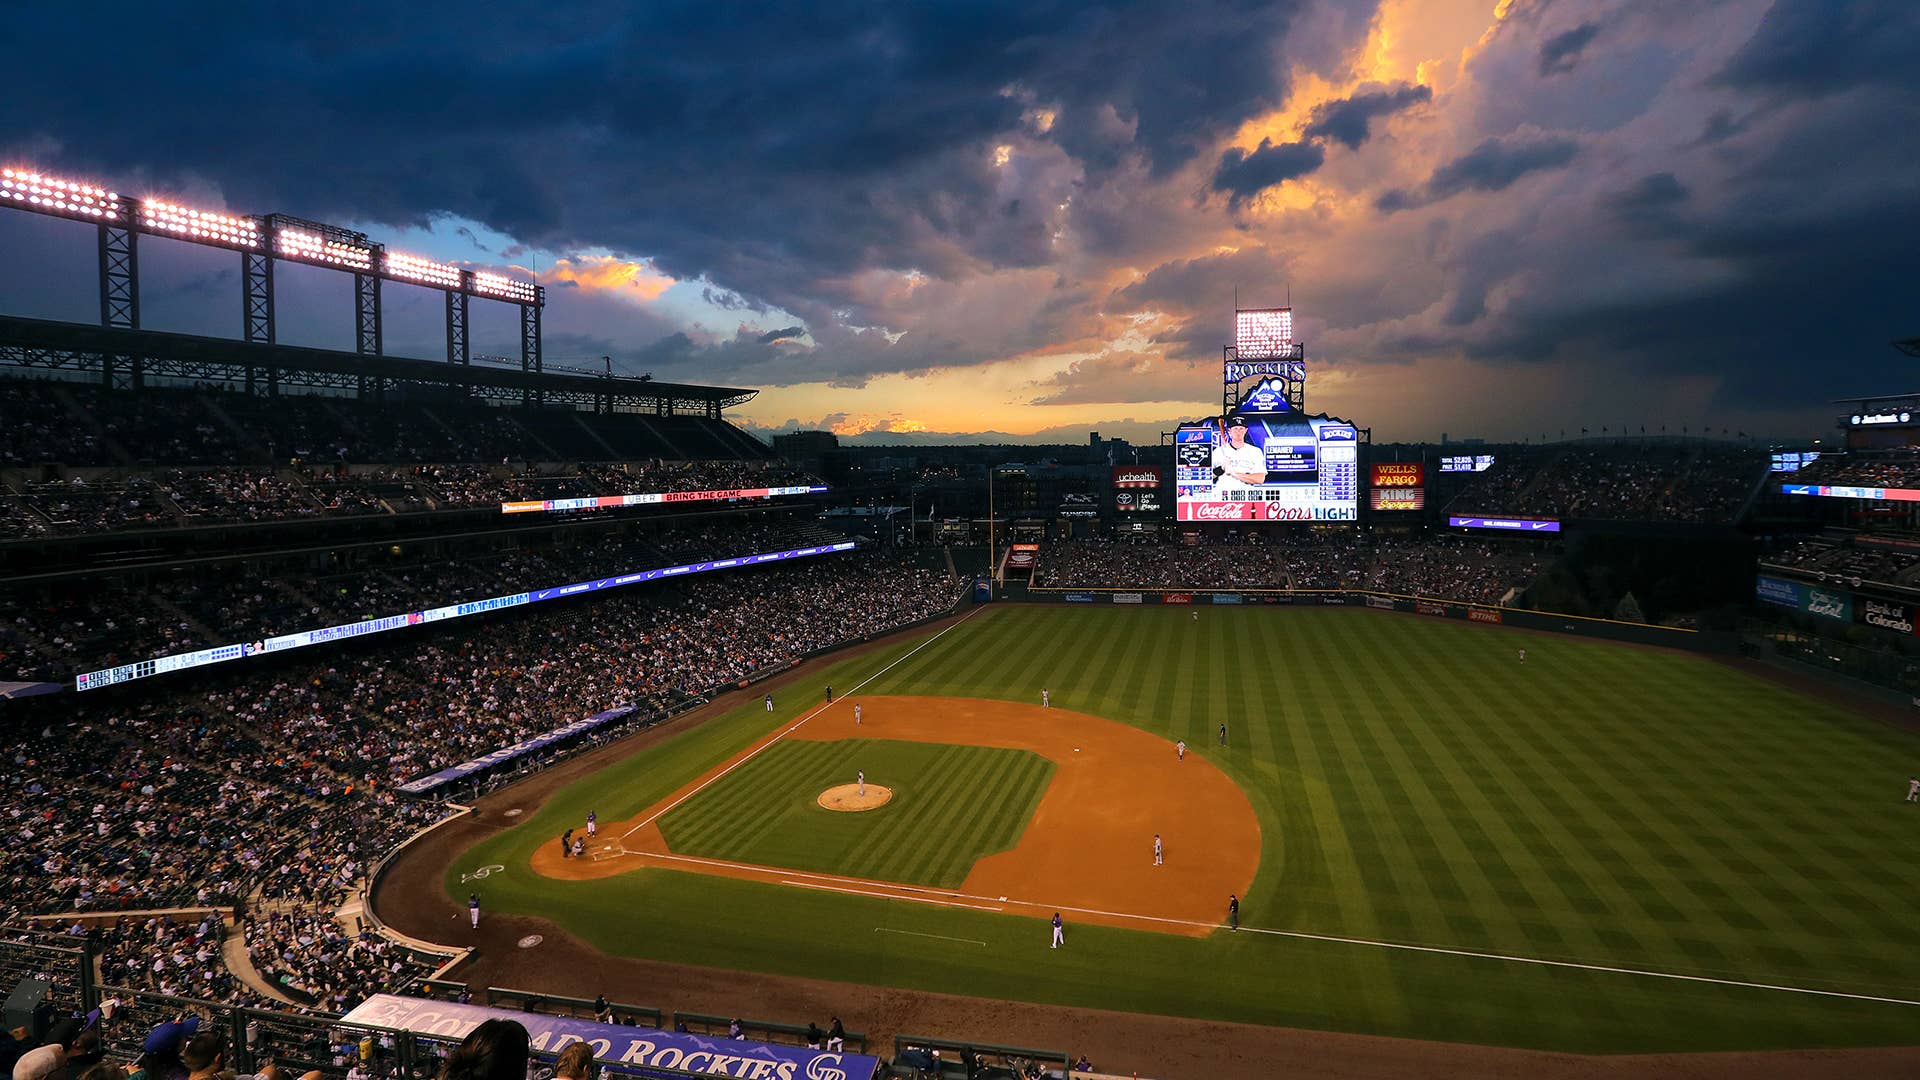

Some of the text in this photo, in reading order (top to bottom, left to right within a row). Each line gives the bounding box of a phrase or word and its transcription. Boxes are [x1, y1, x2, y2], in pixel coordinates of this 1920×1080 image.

[1225, 361, 1306, 382] ROCKIES
[1118, 471, 1156, 481] uchealth
[1378, 465, 1417, 474] WELLS
[1379, 475, 1417, 484] FARGO
[628, 490, 741, 503] UBER BRING THE GAME
[1380, 489, 1416, 500] KING
[1140, 503, 1161, 511] Places
[1197, 503, 1245, 519] Coca-Cola
[1266, 501, 1356, 520] Coors LIGHT
[1866, 600, 1904, 618] Bank of
[1471, 611, 1498, 621] STIHL
[1865, 612, 1912, 632] Colorado
[619, 1038, 798, 1080] ROCKIES
